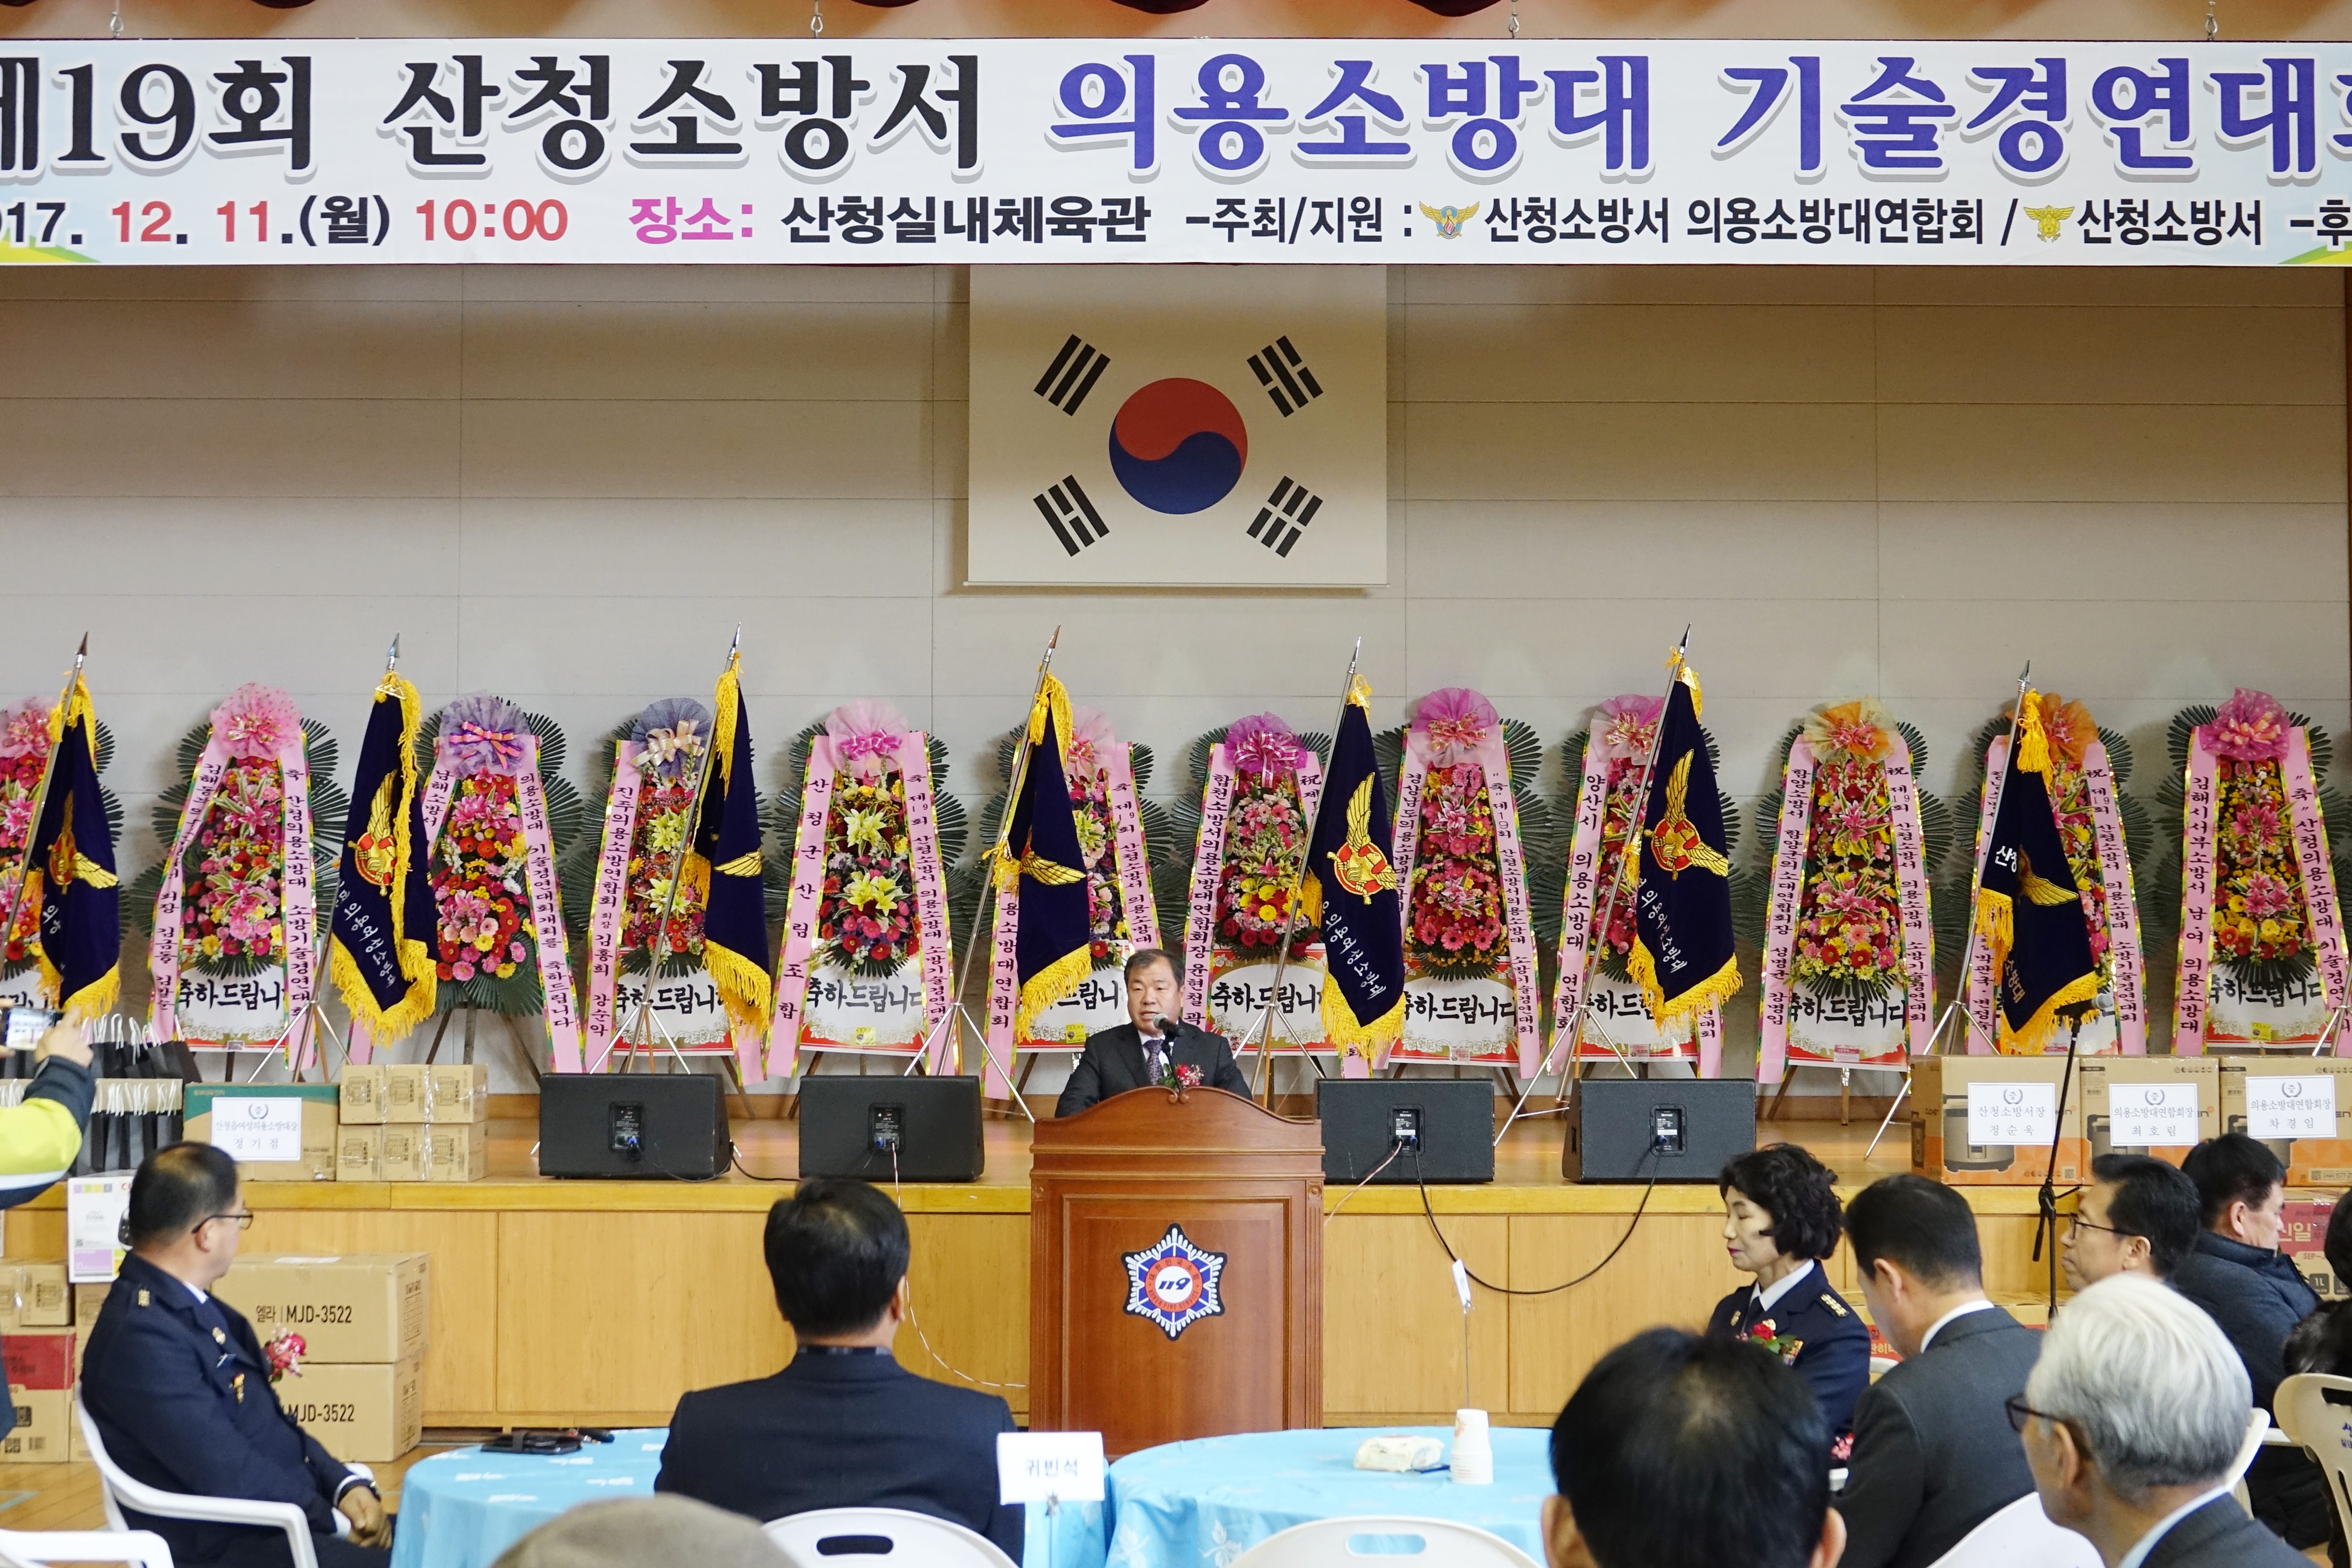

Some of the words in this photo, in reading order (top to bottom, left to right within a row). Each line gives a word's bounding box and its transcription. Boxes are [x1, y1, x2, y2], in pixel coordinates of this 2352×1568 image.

[383, 55, 978, 170] 산청소방서
[1050, 53, 1649, 171] 의용소방대
[1718, 56, 2352, 173] 기술경연대
[111, 200, 188, 245] 12.
[415, 199, 568, 242] 10:00
[629, 196, 753, 245] 장소:
[781, 196, 1152, 244] 산청실내체육관
[1485, 197, 1669, 244] 산청소방서
[1687, 197, 1984, 245] 의용소방대연합회
[2077, 199, 2261, 246] 산청소방서
[423, 769, 454, 827] 남해소방서
[1578, 774, 1606, 831] 양산시
[1785, 769, 1811, 819] 함양소방서
[599, 787, 634, 908] 진주의용소방연합회
[912, 835, 937, 883] 산청소방서
[1894, 822, 1918, 870] 산청소방서
[2096, 824, 2121, 870] 산청소방서
[2188, 776, 2211, 895] 김해시서부소방서
[1120, 843, 1144, 888] 산청소방서
[2296, 818, 2334, 929] 산청의용소방대
[520, 773, 543, 830] 의용소방대
[544, 961, 575, 1028] 축하드립니다
[601, 912, 612, 929] 회장
[920, 889, 943, 939] 의용소방대
[1129, 894, 1152, 943] 의용소방대
[1565, 851, 1592, 951] 의용소방대
[1902, 880, 1923, 929] 의용소방대
[2106, 881, 2130, 930] 의용소방대
[991, 891, 1019, 1029] 용소방대연합회
[1326, 913, 1387, 1000] 의용여성소방대
[180, 978, 285, 1011] 축하드립니
[616, 984, 724, 1014] 축하드립니
[1211, 982, 1322, 1014] 축하드립니
[1512, 956, 1534, 1034] 소방기술경연대회
[1907, 942, 1929, 1022] 소방기술경연대회
[2114, 941, 2137, 1023] 소방기술경연대회
[2180, 958, 2205, 1033] 의용소방대
[1978, 1106, 2046, 1118] 산청소방서장
[2113, 1107, 2194, 1118] 의용소방대연합회장
[2251, 1098, 2331, 1111] 의용소방대연합회장
[1158, 1277, 1191, 1290] 119
[286, 1305, 352, 1323] MJD-3522
